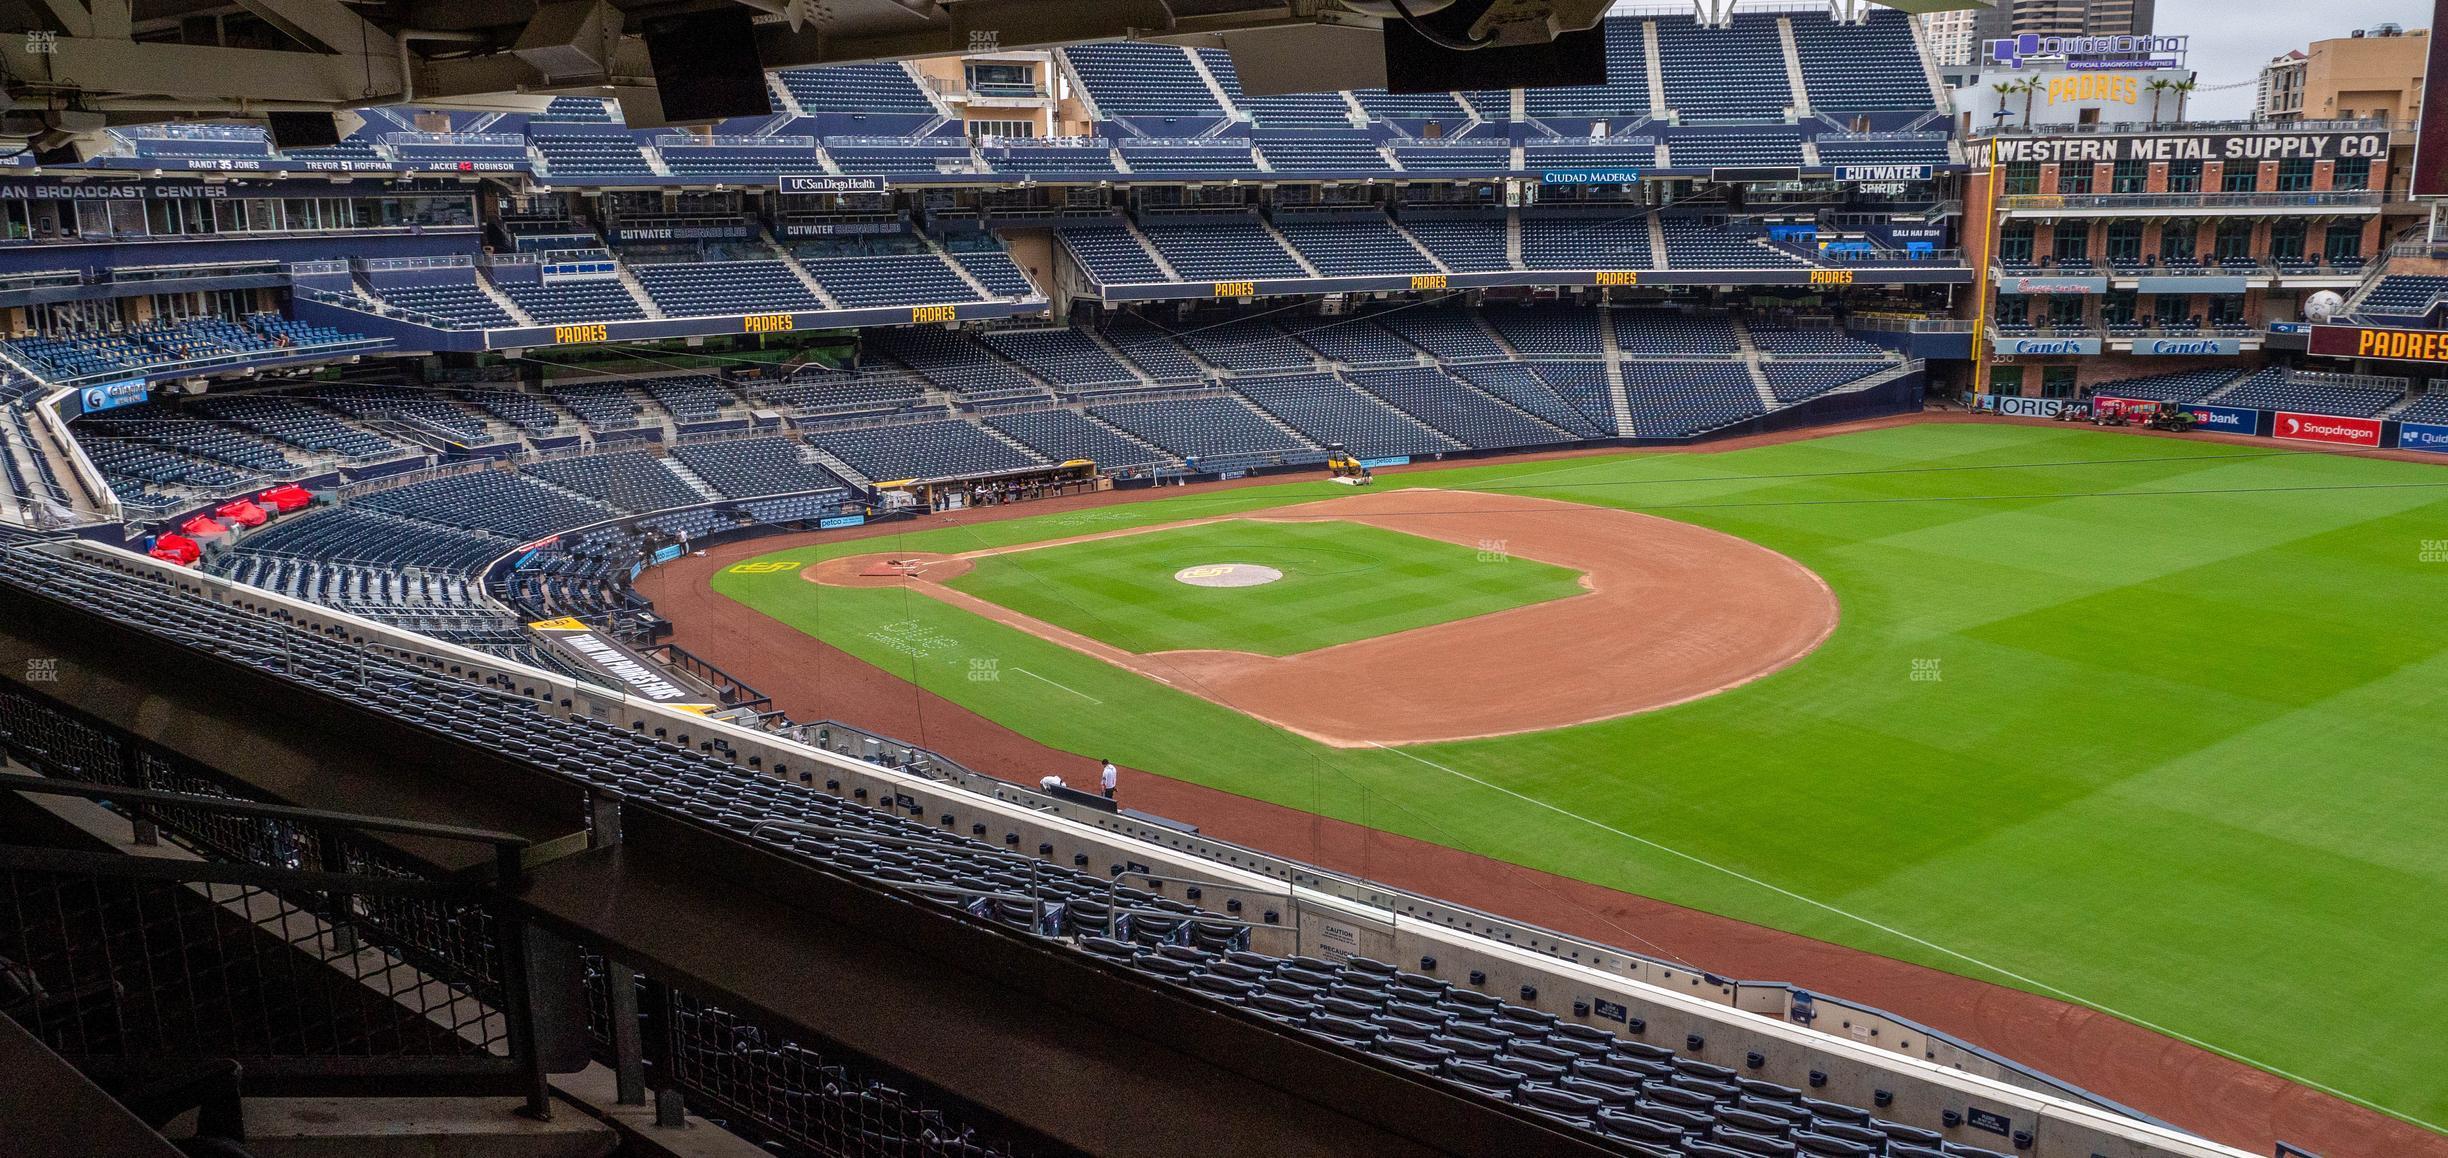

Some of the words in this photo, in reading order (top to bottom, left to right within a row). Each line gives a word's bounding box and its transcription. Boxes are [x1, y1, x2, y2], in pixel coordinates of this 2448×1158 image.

[2045, 35, 2179, 57] QuidelOrtho
[2048, 74, 2138, 106] PADRES
[1996, 140, 2117, 161] WESTERN
[2131, 138, 2217, 160] METAL
[2225, 136, 2330, 158] SUPPLY
[2340, 136, 2385, 157] CO.
[188, 160, 217, 169] RANDY
[219, 159, 232, 170] 35
[234, 161, 260, 169] JONES
[306, 161, 339, 170] TREVOR
[341, 160, 353, 171] 51
[354, 162, 393, 170] HOFFMAN
[429, 162, 458, 170] JACKIE
[459, 161, 472, 171] 42
[474, 162, 514, 170] ROBINSON
[1545, 172, 1587, 183] CIUDAD
[1590, 172, 1637, 182] MADERAS
[1845, 166, 1921, 180] CUTWATER
[35, 185, 146, 198] BROADCAST
[155, 185, 228, 198] CENTER
[791, 179, 806, 190] UC
[806, 179, 824, 190] San
[824, 179, 848, 191] Diego
[848, 179, 876, 189] Health
[620, 228, 672, 239] CUTWATER
[787, 225, 833, 236] CUTWATER
[1924, 229, 1940, 237] RUM
[1411, 276, 1447, 289] PADRES
[1596, 272, 1637, 285] PADRES
[1811, 271, 1853, 284] PADRES
[1215, 282, 1254, 296] PADRES
[912, 306, 957, 323] PADRES
[744, 315, 793, 332] PADRES
[556, 325, 607, 343] PADRES
[2015, 339, 2081, 354] Canel's
[2152, 339, 2219, 354] Canel's
[2358, 329, 2448, 360] PADRES
[2003, 398, 2060, 418] ORIS
[2209, 411, 2240, 425] bank
[2303, 422, 2373, 439] Snapdragon
[821, 518, 842, 527] petco
[603, 659, 663, 683] PADRES
[636, 680, 688, 698] FANS
[1325, 925, 1353, 938] CAUTION
